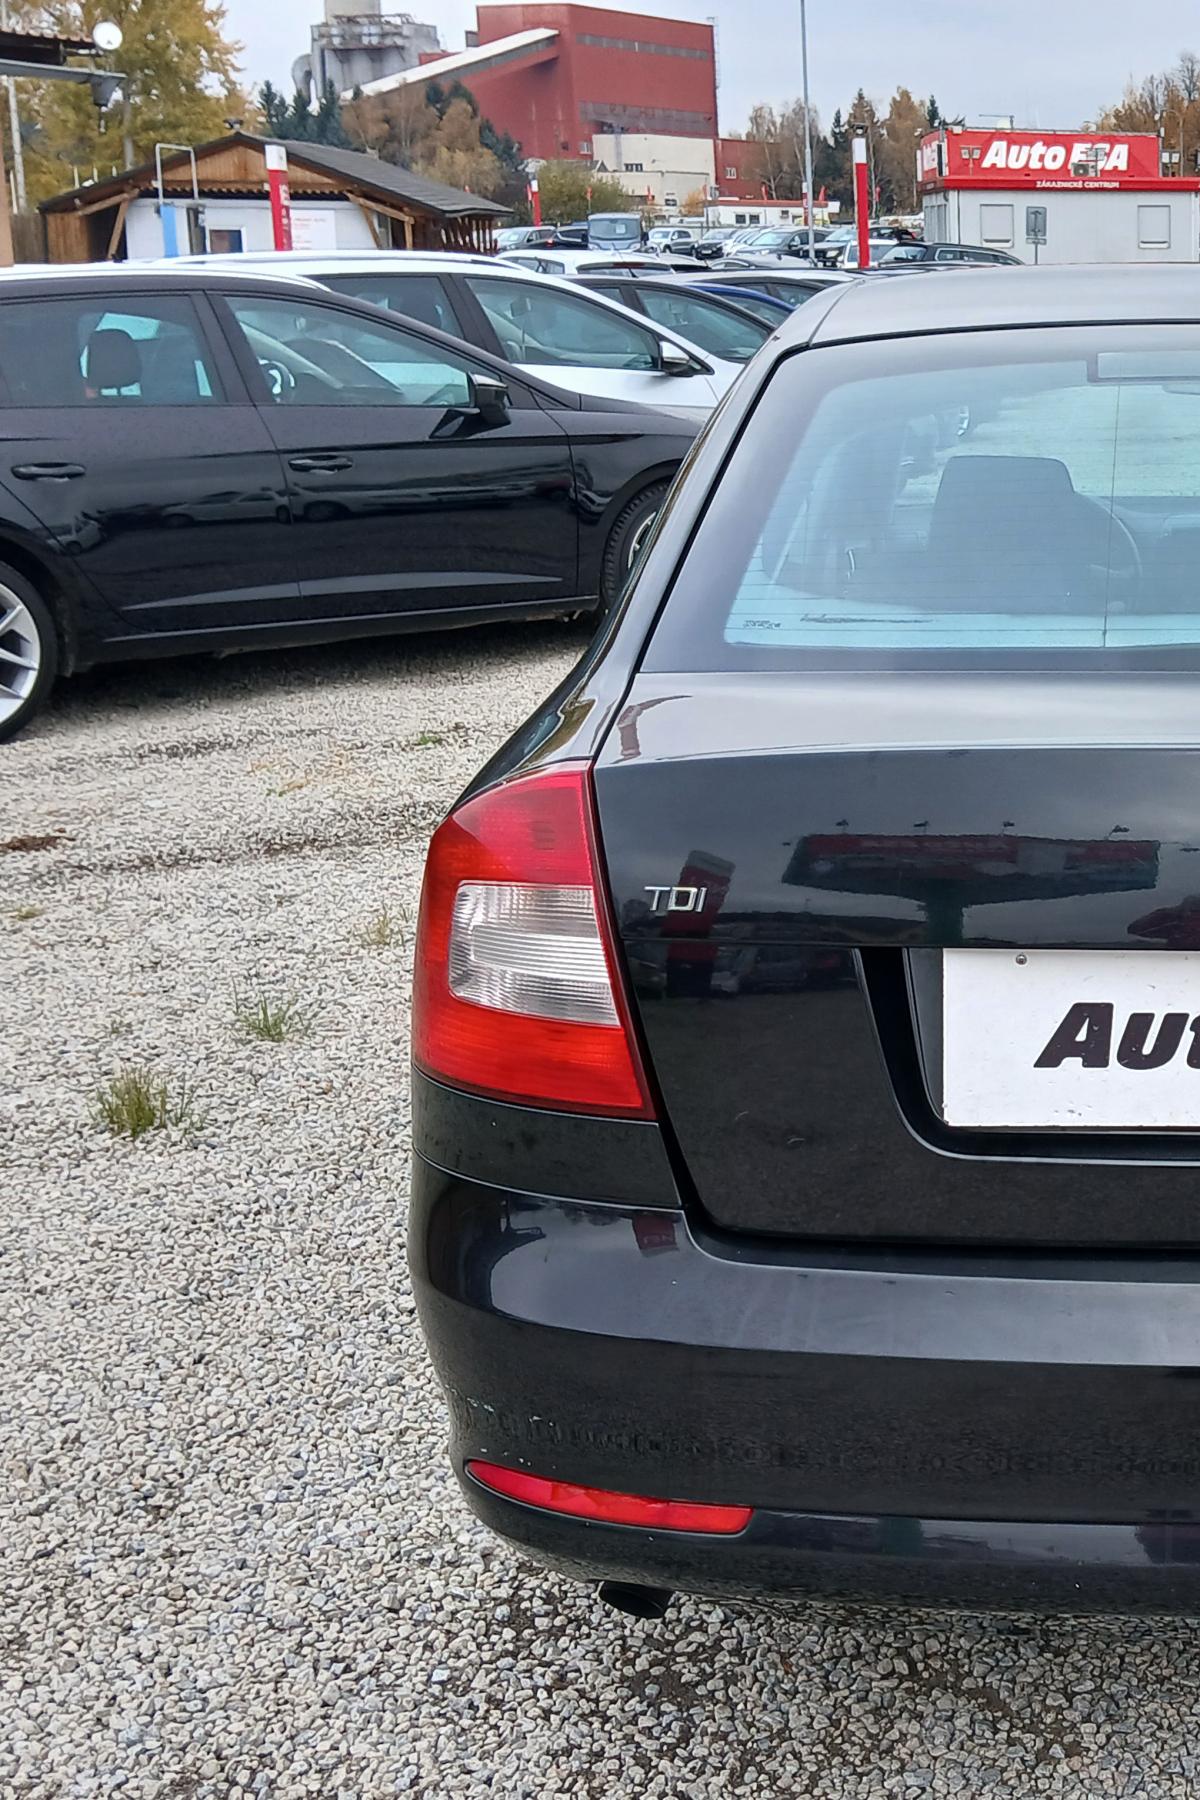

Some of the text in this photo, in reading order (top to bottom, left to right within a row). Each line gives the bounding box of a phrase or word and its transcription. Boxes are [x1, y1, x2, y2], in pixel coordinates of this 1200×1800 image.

[981, 140, 1129, 171] Auto ESA
[643, 886, 708, 912] TDI
